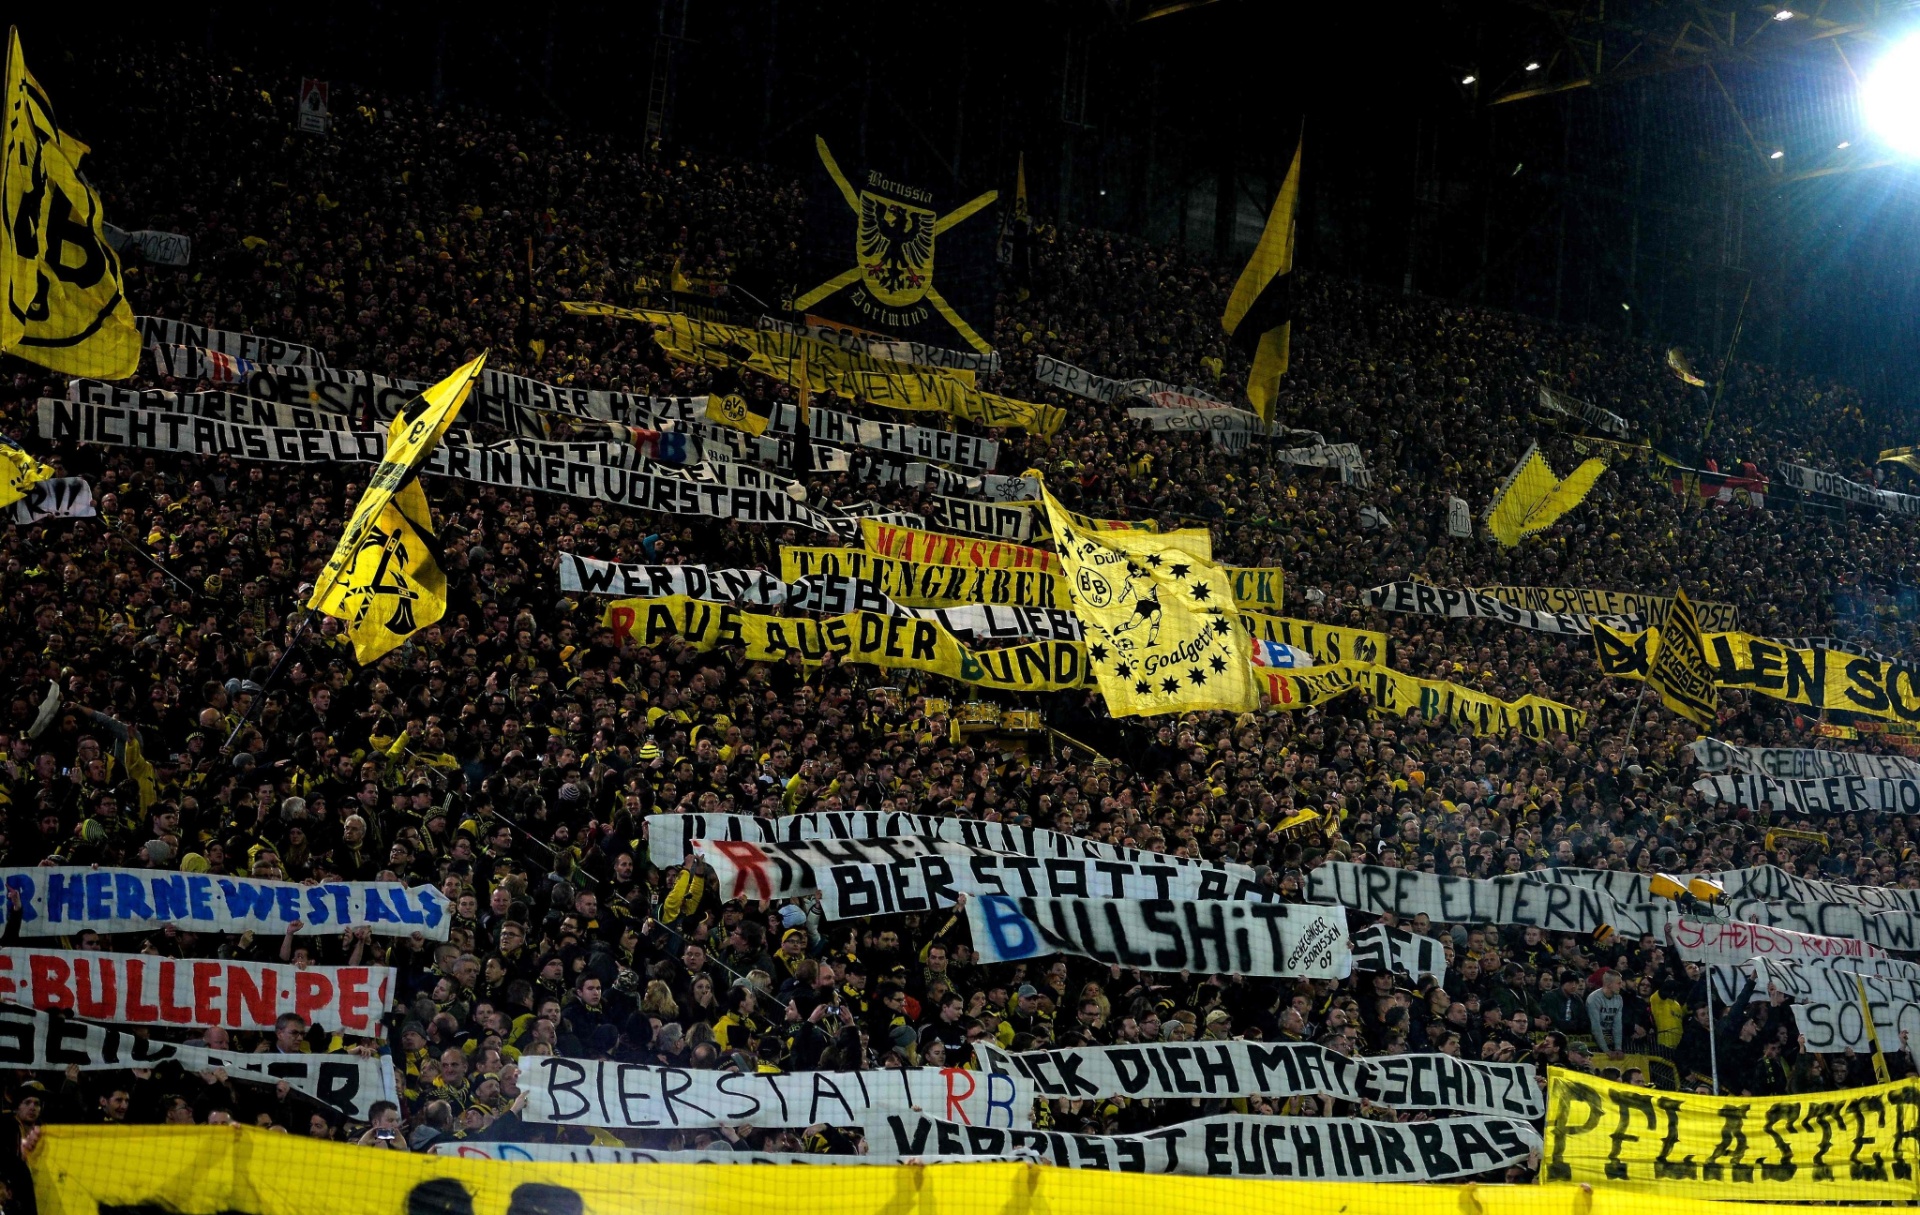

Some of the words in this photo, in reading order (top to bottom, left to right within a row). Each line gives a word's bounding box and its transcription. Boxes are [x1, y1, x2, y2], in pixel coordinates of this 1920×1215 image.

[866, 169, 934, 204] Borussia
[850, 286, 929, 328] Dortmund
[1040, 357, 1080, 389] DER
[52, 401, 188, 449] NICHT
[490, 371, 592, 417] UNSER
[879, 424, 988, 469] FLÜGEL
[724, 397, 744, 416] BVB
[1165, 409, 1233, 431] reichen
[1814, 472, 1888, 506] COESFELD
[877, 527, 1064, 576] MATESCHI
[572, 555, 674, 597] WER
[684, 565, 753, 601] DEN
[983, 605, 1080, 641] LIEBT
[793, 551, 1056, 609] TOTENGRÄBER
[1370, 582, 1539, 628] VERPISST
[1526, 588, 1554, 614] MIR
[1555, 588, 1618, 615] SPIELE
[1691, 600, 1740, 632] OSEN
[611, 601, 748, 649] RAUS
[765, 619, 851, 661] AUS
[858, 613, 937, 661] DER
[960, 641, 1097, 684] BUND
[1761, 749, 1826, 778] GEGEN
[48, 873, 215, 922] HERNE
[217, 879, 352, 926] WEST
[365, 887, 447, 928] ALS
[829, 854, 963, 919] BIER
[970, 856, 1178, 901] STATT
[1307, 863, 1419, 919] EURE
[1439, 873, 1611, 932] ELTERN
[1735, 897, 1920, 949] GESCHW
[1303, 925, 1341, 970] BORUSSEN
[1676, 917, 1793, 955] SCHEISS
[1319, 951, 1333, 970] 09
[30, 954, 278, 1027] BULLEN
[293, 966, 388, 1031] PE
[986, 1045, 1099, 1098] FICK
[1105, 1044, 1238, 1095] DICH
[1249, 1043, 1540, 1118] MATESCHITZ!
[886, 1115, 1187, 1175] VERPISST
[1205, 1120, 1325, 1178] EUCH
[1330, 1120, 1416, 1178] IHR
[1408, 1115, 1532, 1178] BAS
